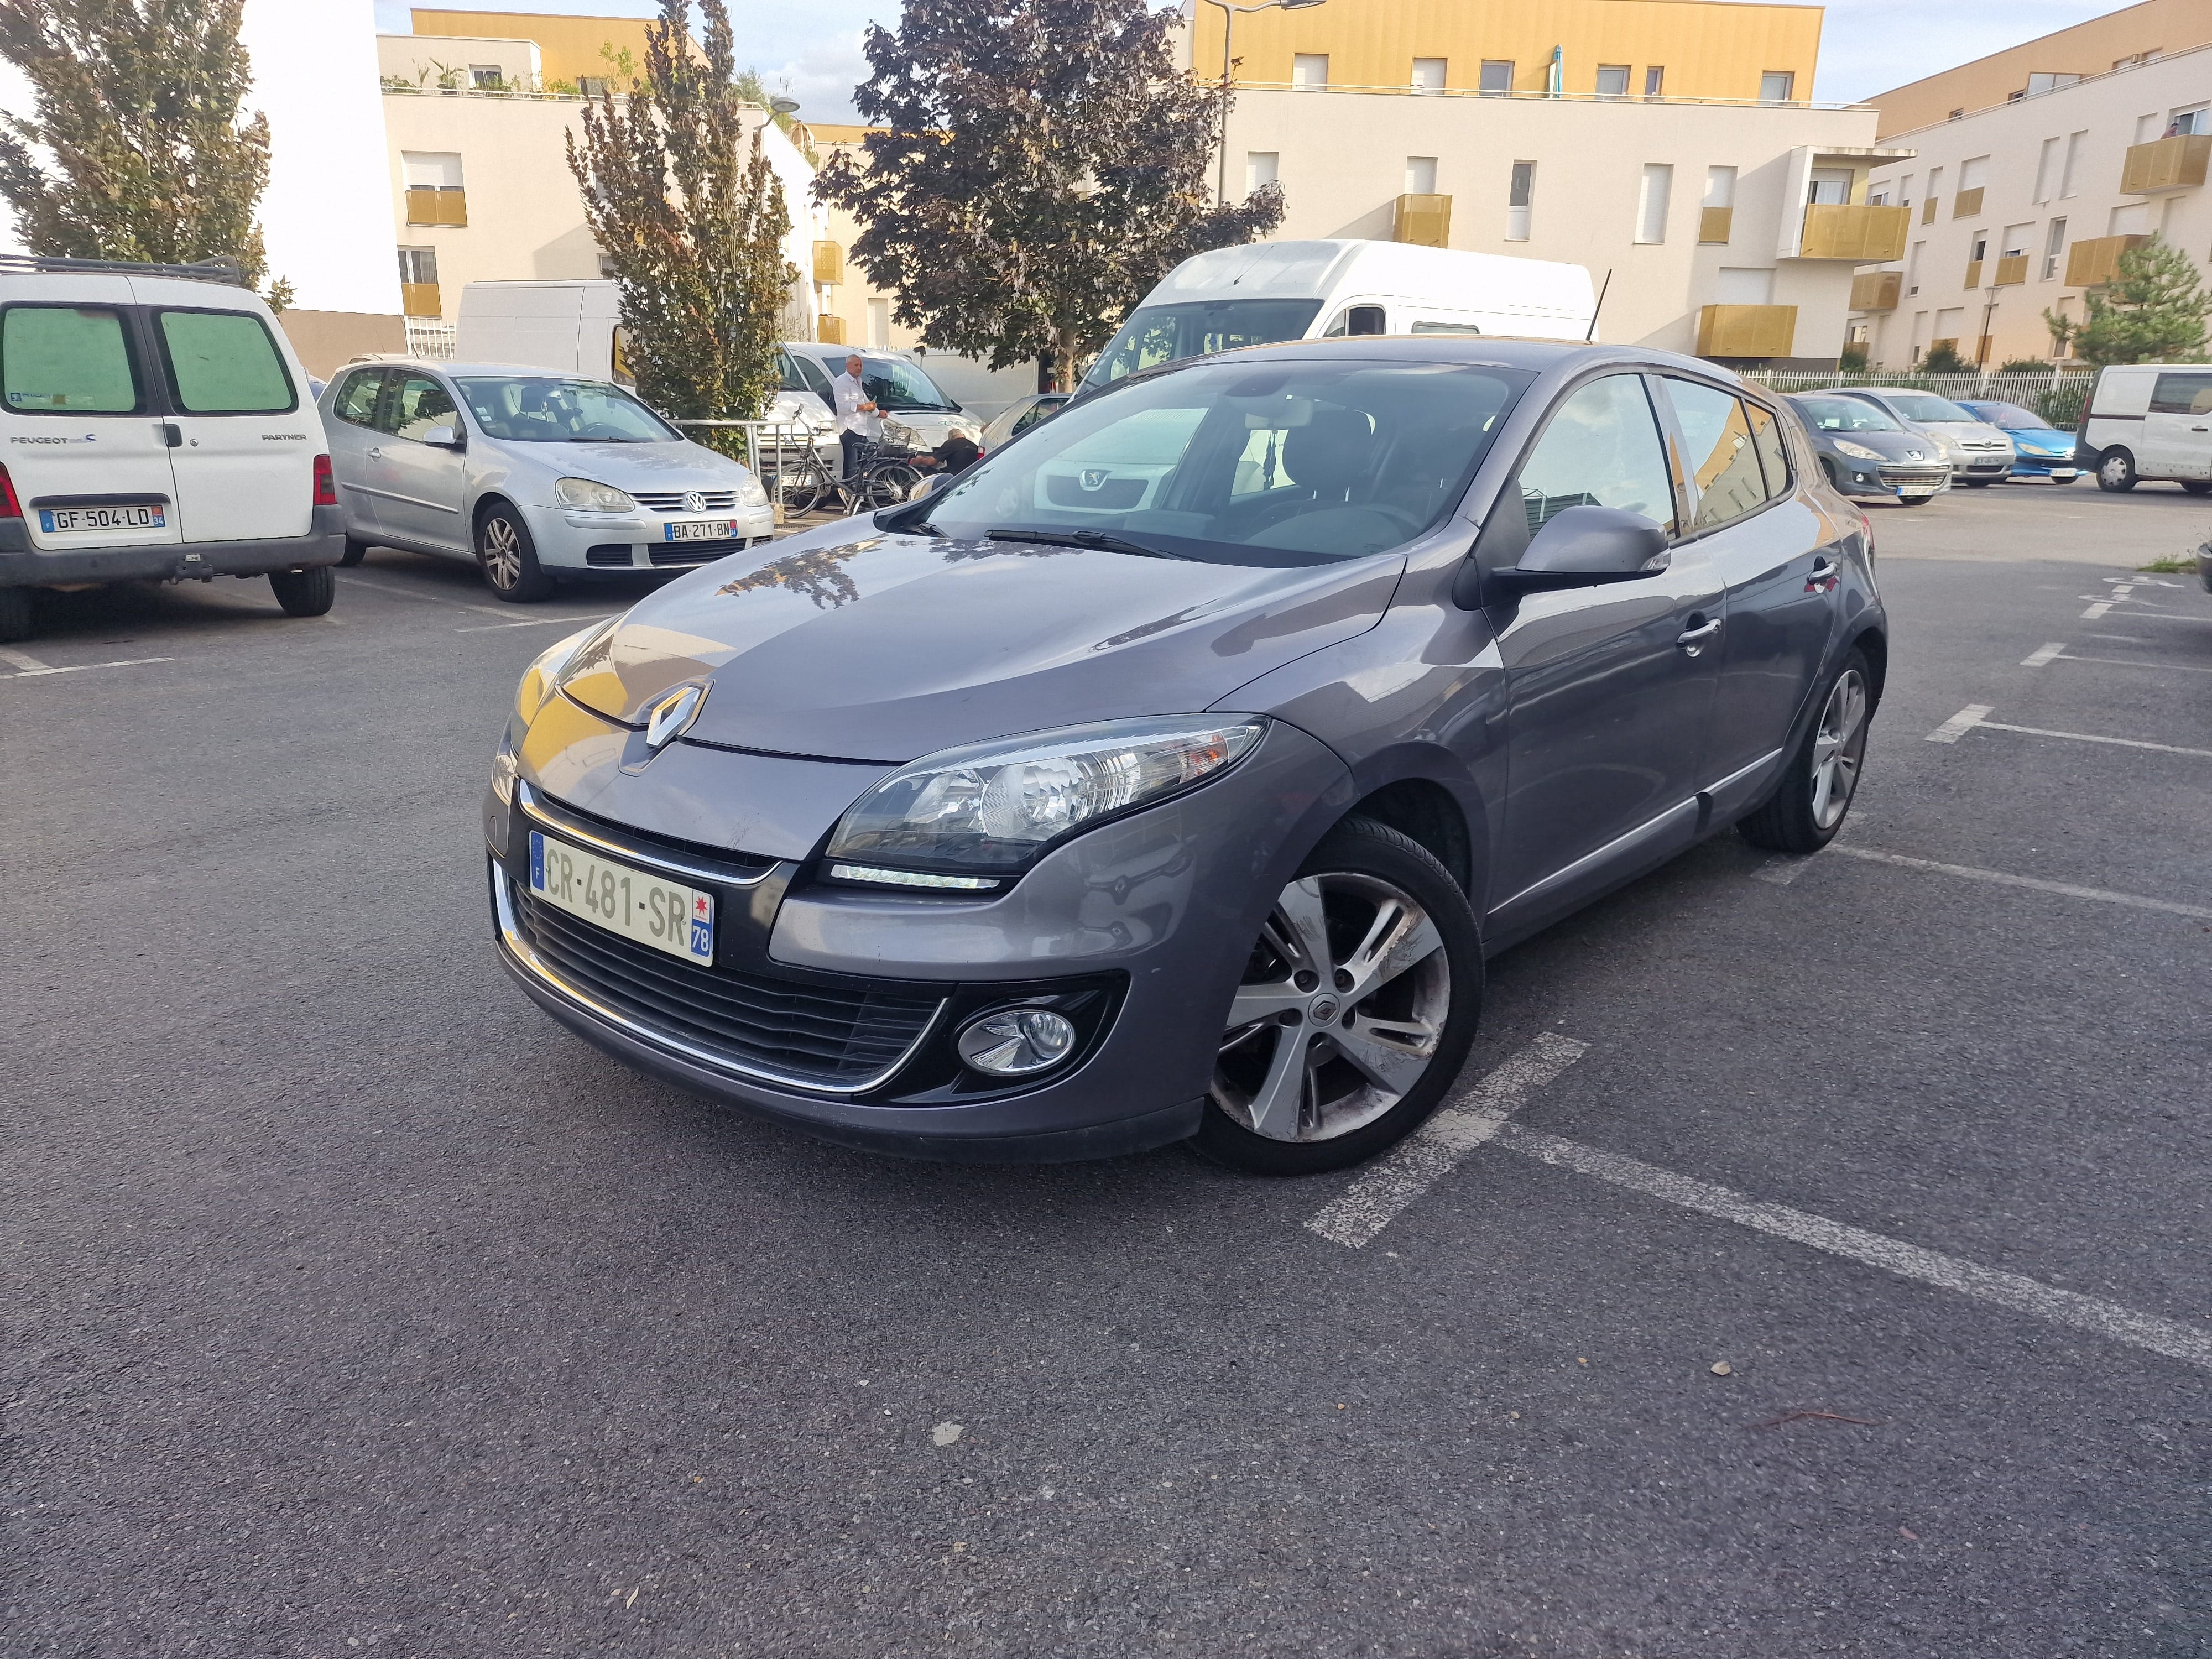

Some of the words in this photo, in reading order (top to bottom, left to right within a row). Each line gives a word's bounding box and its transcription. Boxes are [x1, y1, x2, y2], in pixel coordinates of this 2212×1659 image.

[56, 509, 149, 529] GF-504-LD
[153, 517, 163, 525] 34
[674, 523, 730, 539] BA-271-BN
[535, 867, 540, 880] F
[547, 849, 686, 946] CR-481-SR
[692, 925, 709, 952] 78
